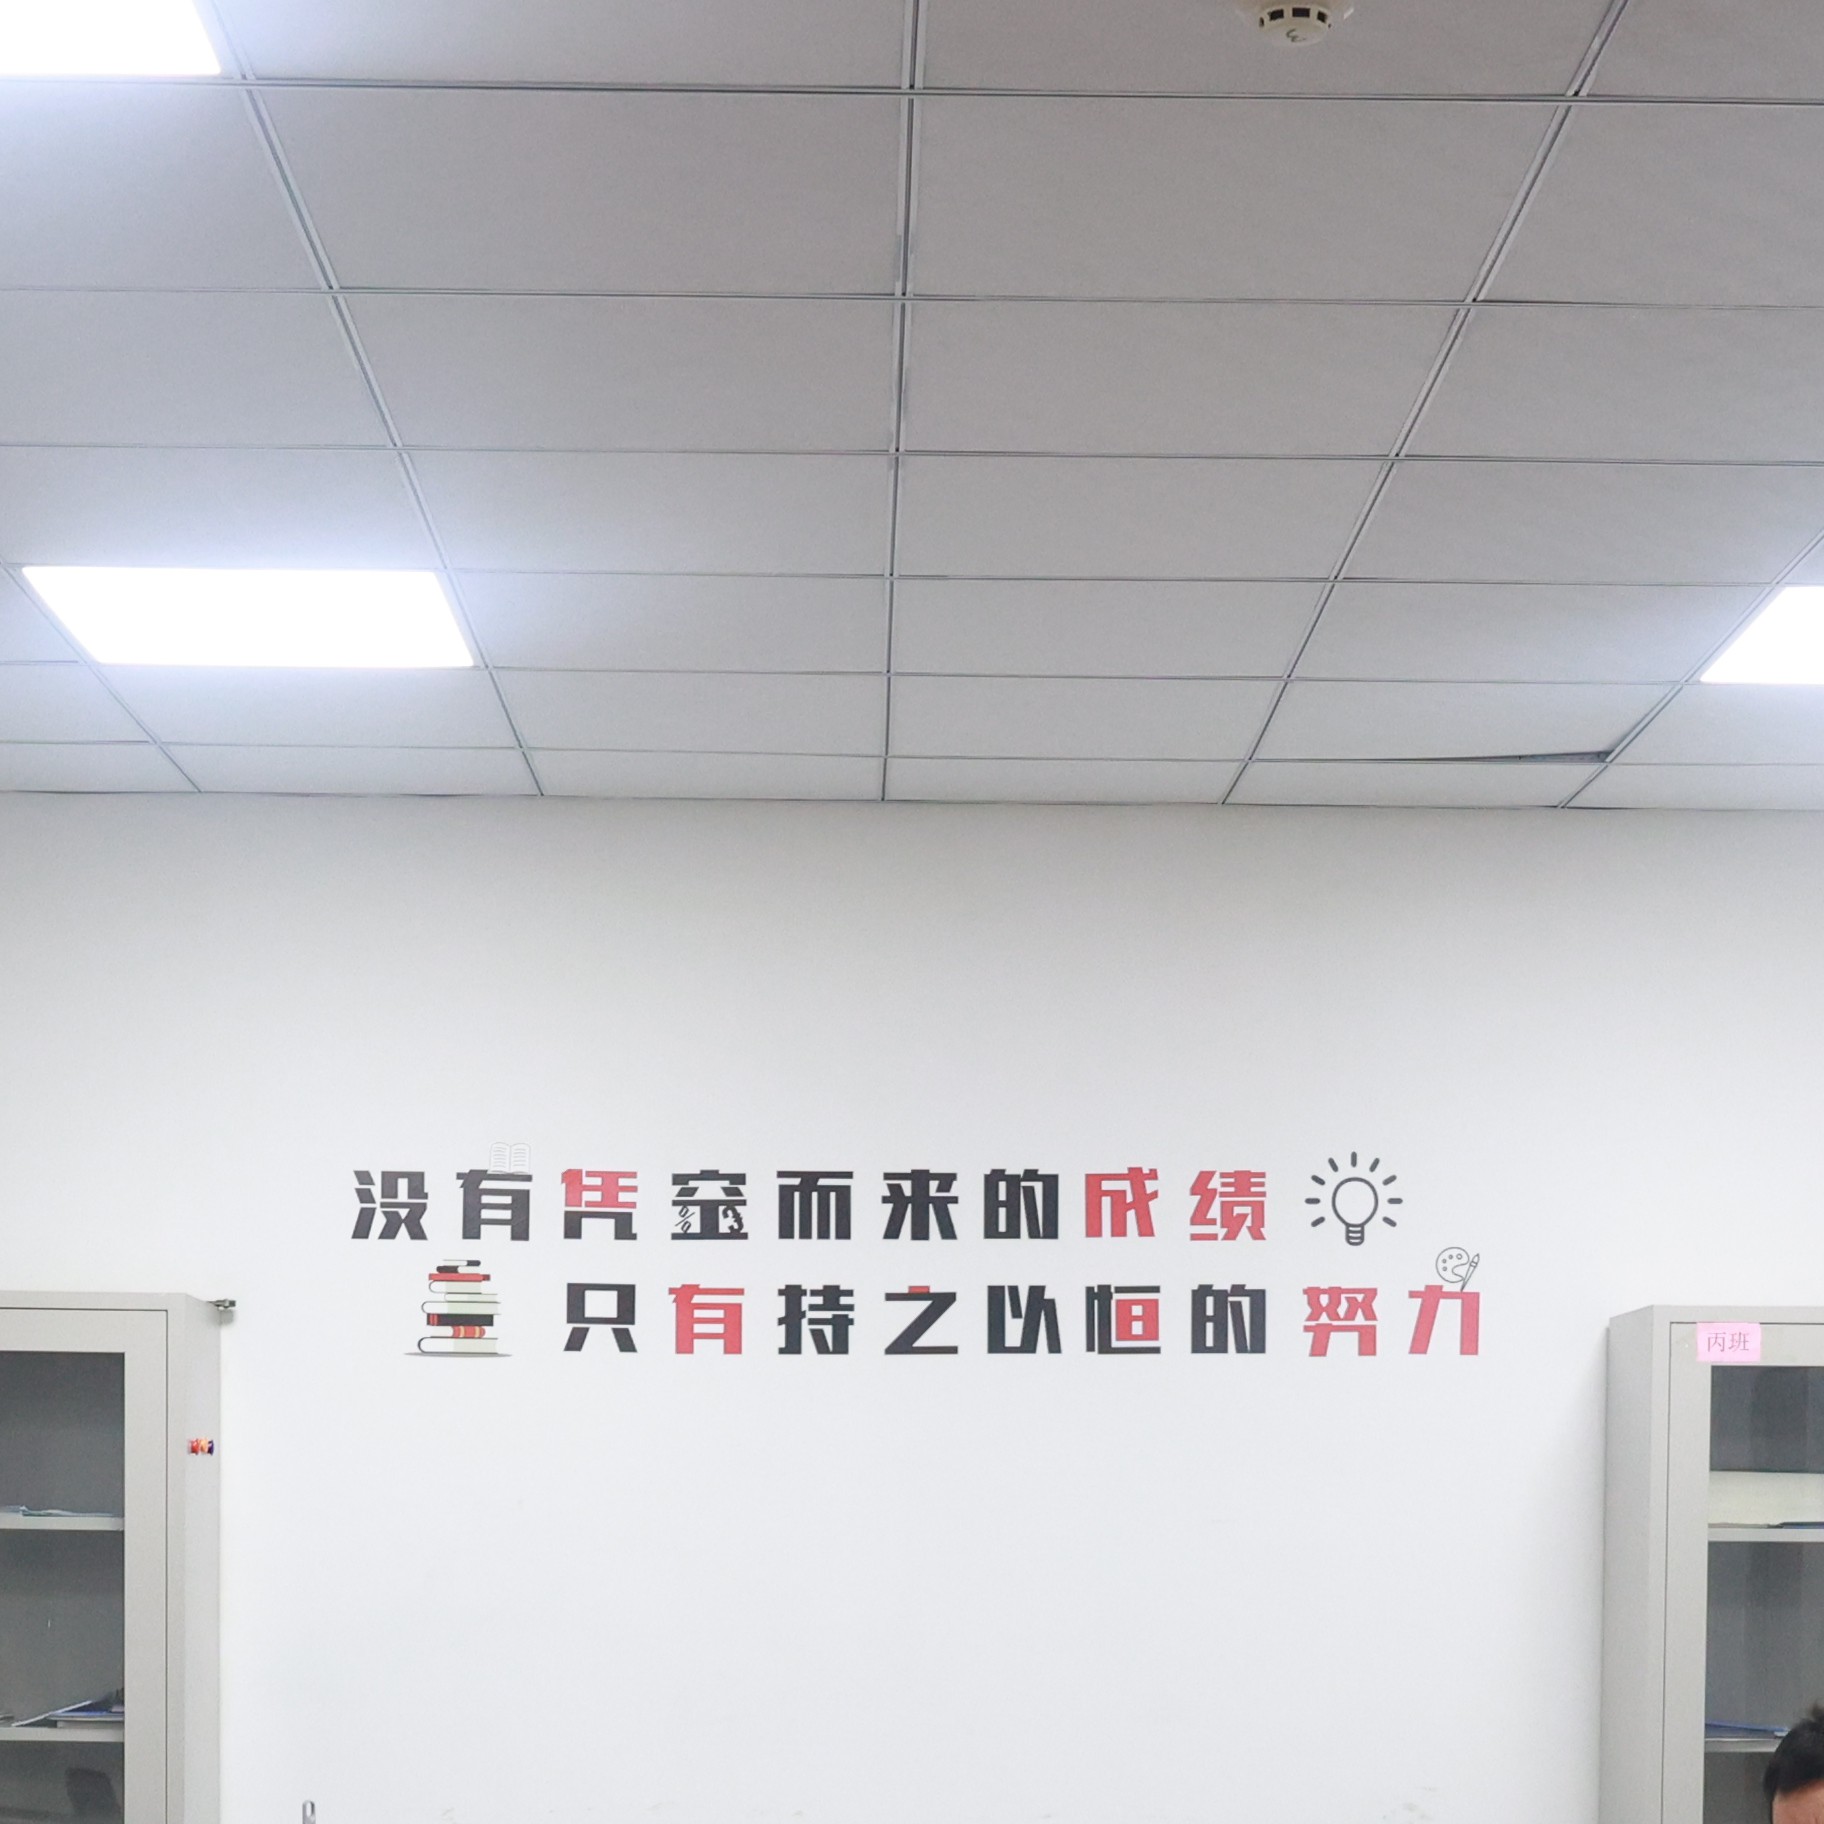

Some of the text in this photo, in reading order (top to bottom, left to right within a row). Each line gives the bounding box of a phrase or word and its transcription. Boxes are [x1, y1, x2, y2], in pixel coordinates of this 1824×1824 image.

[351, 1167, 1266, 1242] 没有凭空而来的成绩
[563, 1282, 1481, 1358] 只有持之以恒的努力
[1707, 1331, 1750, 1353] 丙班
